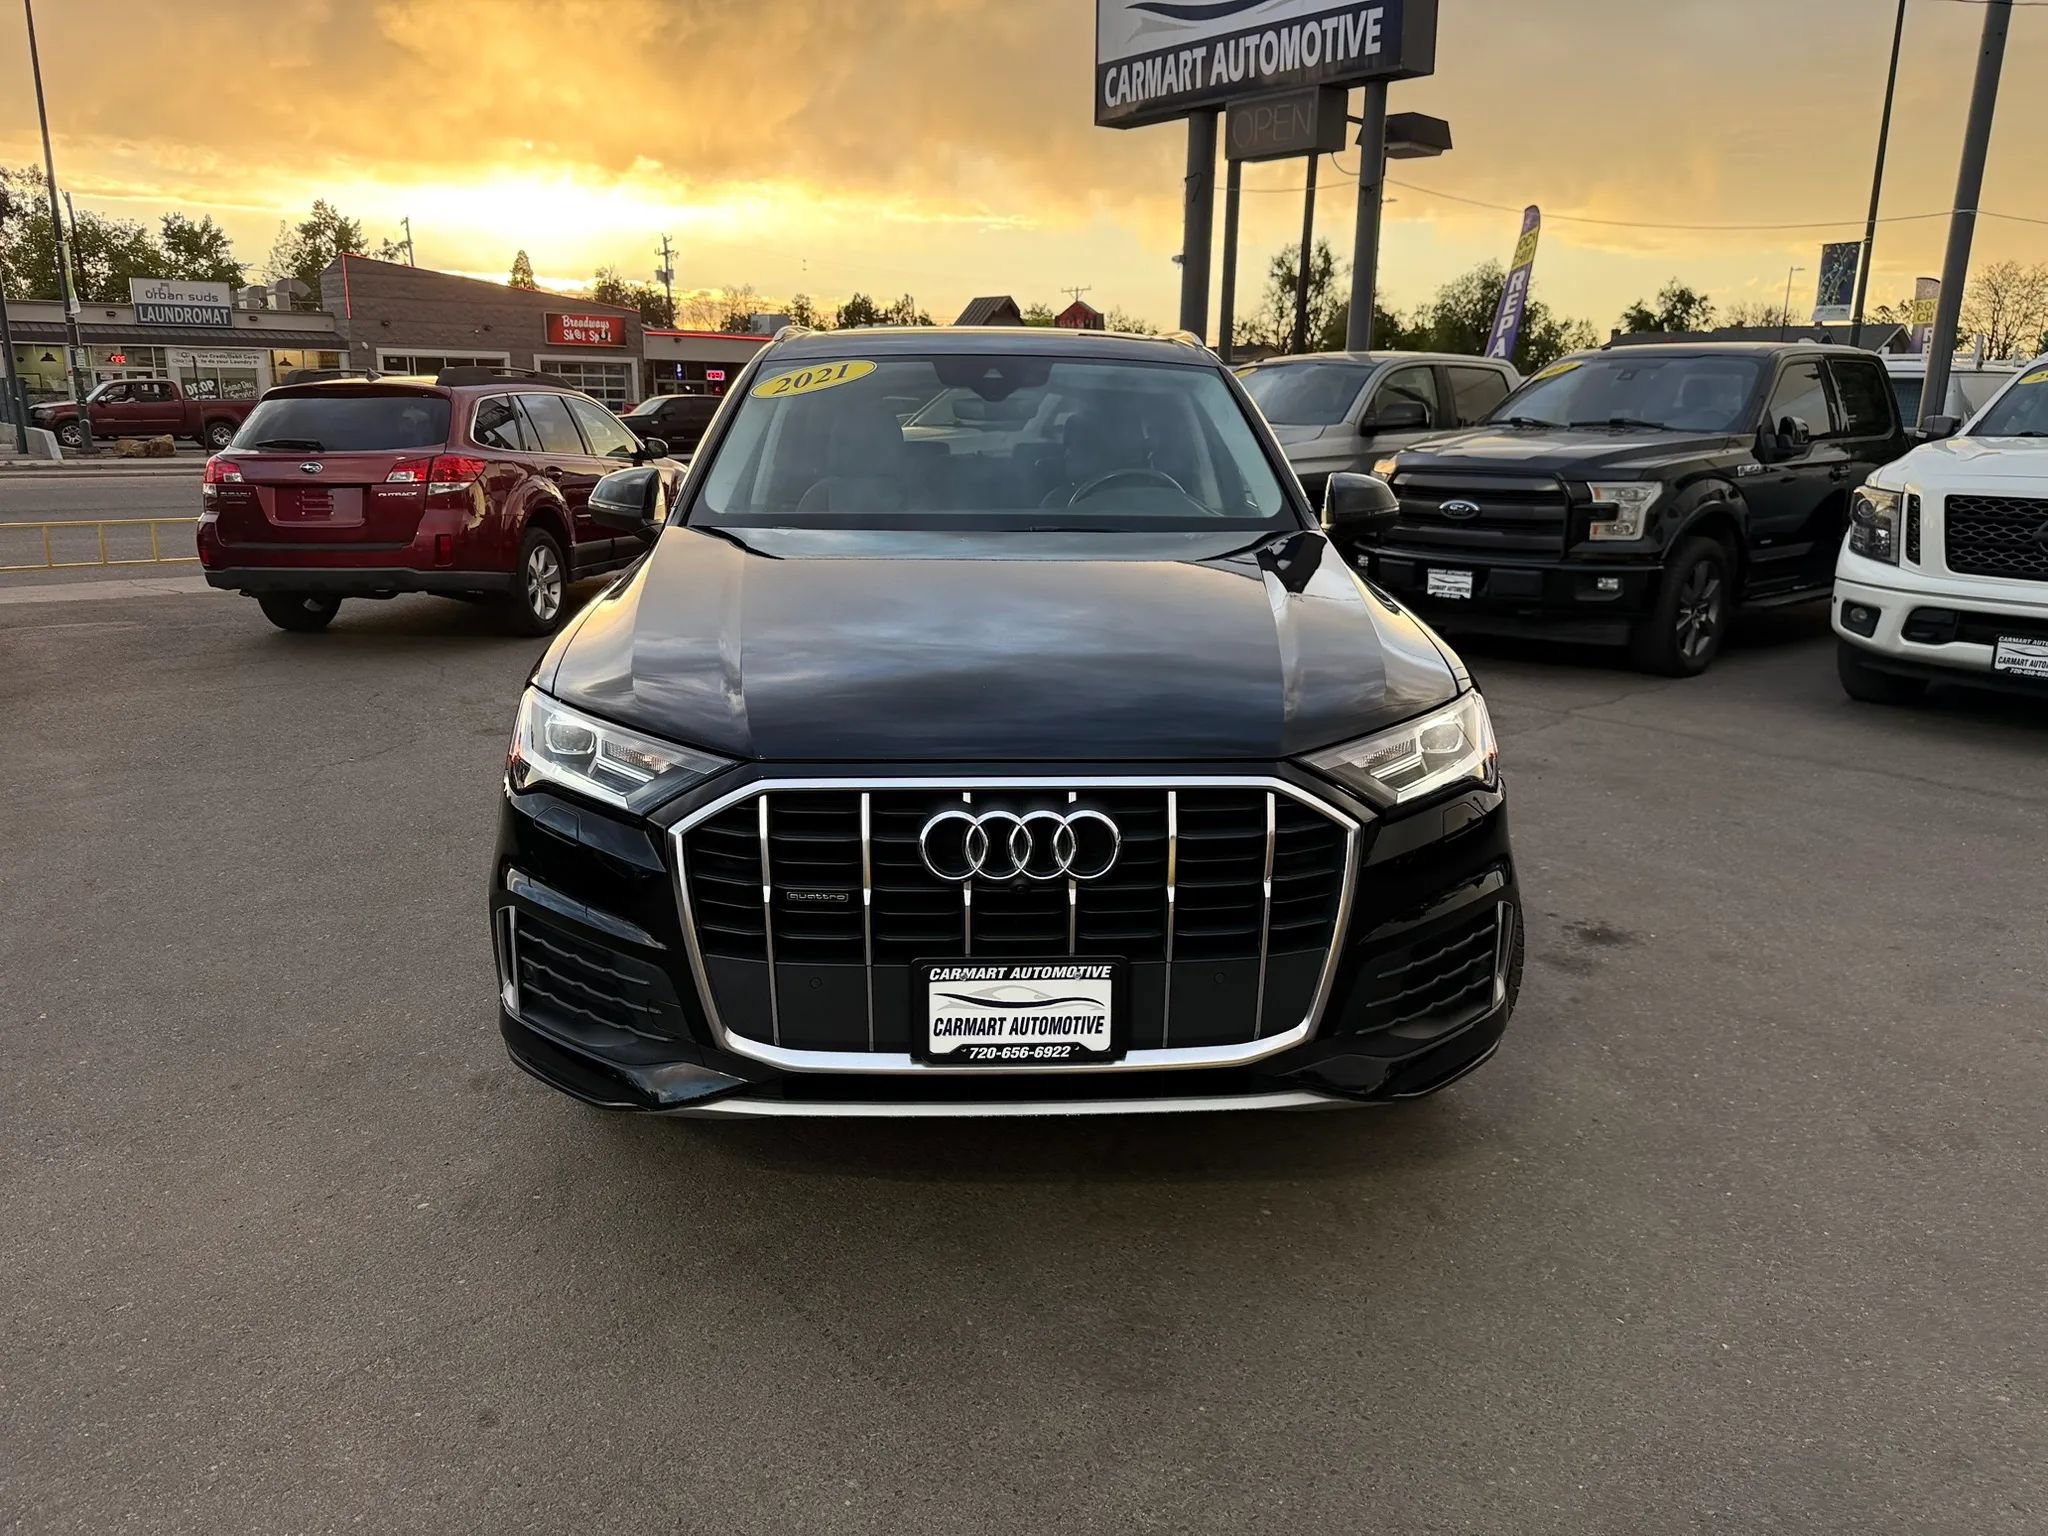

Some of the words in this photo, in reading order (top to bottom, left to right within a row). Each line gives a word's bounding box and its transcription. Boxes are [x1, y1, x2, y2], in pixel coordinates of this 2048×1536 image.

[1104, 46, 1207, 108] CARMART
[1210, 6, 1385, 87] AUTOMOTIVE
[1231, 101, 1314, 149] OPEN
[188, 292, 219, 303] suds
[138, 306, 229, 325] LAUNDROMAT
[1489, 270, 1526, 358] REPA
[772, 363, 849, 395] 2021
[1998, 656, 2029, 666] CARMART
[929, 968, 1007, 980] CARMART
[1010, 966, 1112, 979] AUTOMOTIVE
[933, 1017, 1006, 1037] CARMART
[1009, 1015, 1105, 1036] AUTOMOTIVE
[969, 1046, 1071, 1059] 720-656-6922
